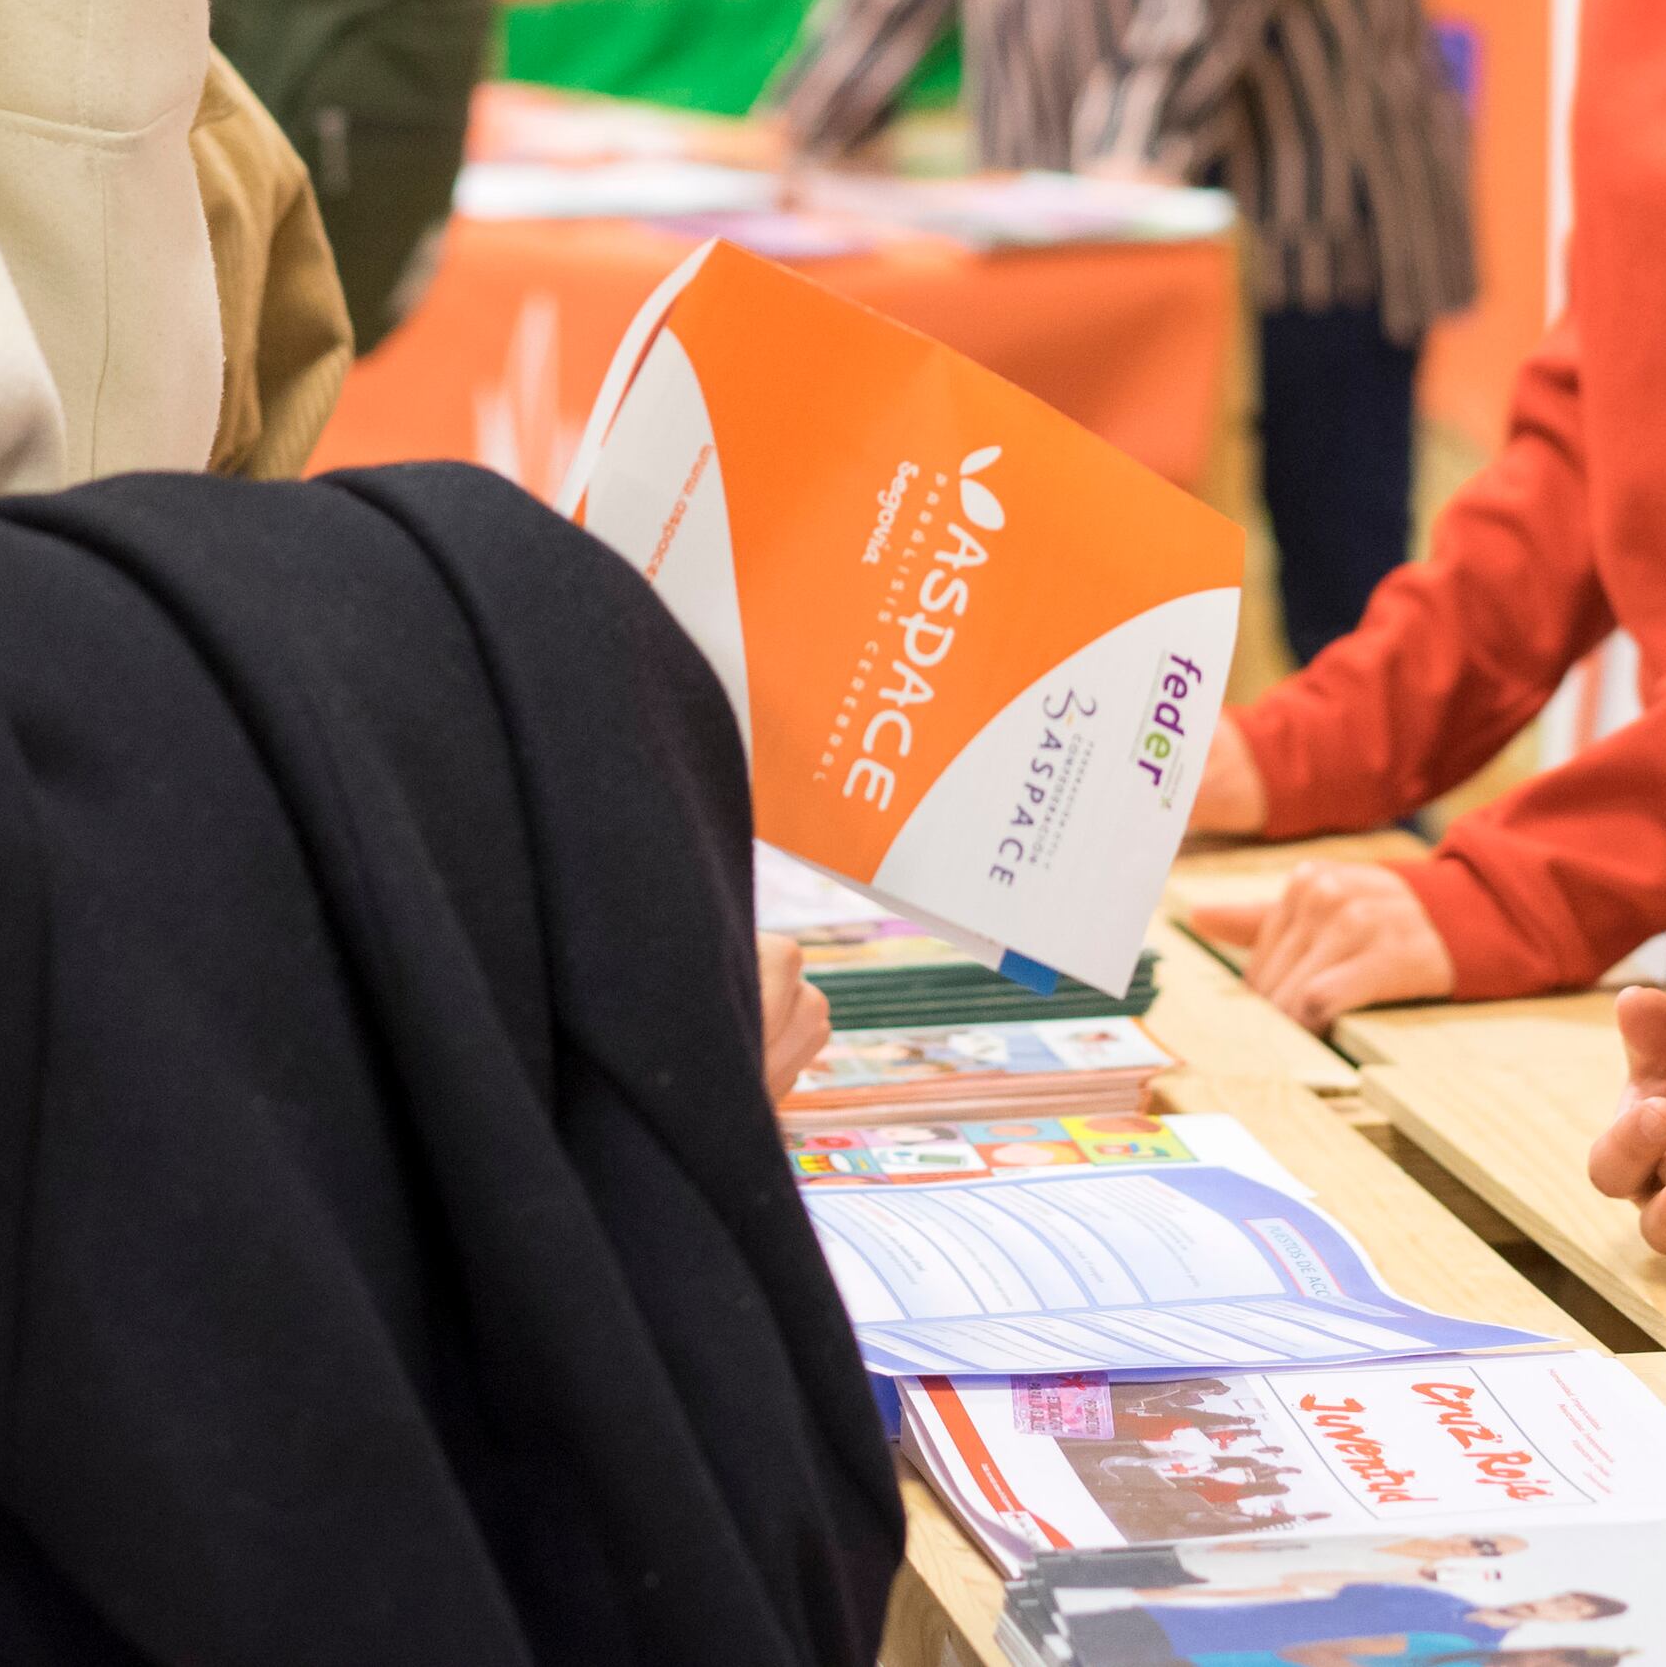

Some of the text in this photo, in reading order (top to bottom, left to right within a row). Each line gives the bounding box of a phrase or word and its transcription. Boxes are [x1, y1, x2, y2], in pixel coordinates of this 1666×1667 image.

[861, 460, 920, 565] Segovia
[812, 640, 880, 782] CEREBRAL
[843, 521, 990, 812] ASPACE
[1137, 653, 1202, 787] feder
[989, 728, 1062, 887] ASPACE
[1296, 1259, 1318, 1274] DE
[1299, 1392, 1439, 1505] Juventud
[1411, 1381, 1554, 1503] Cruz Roja
